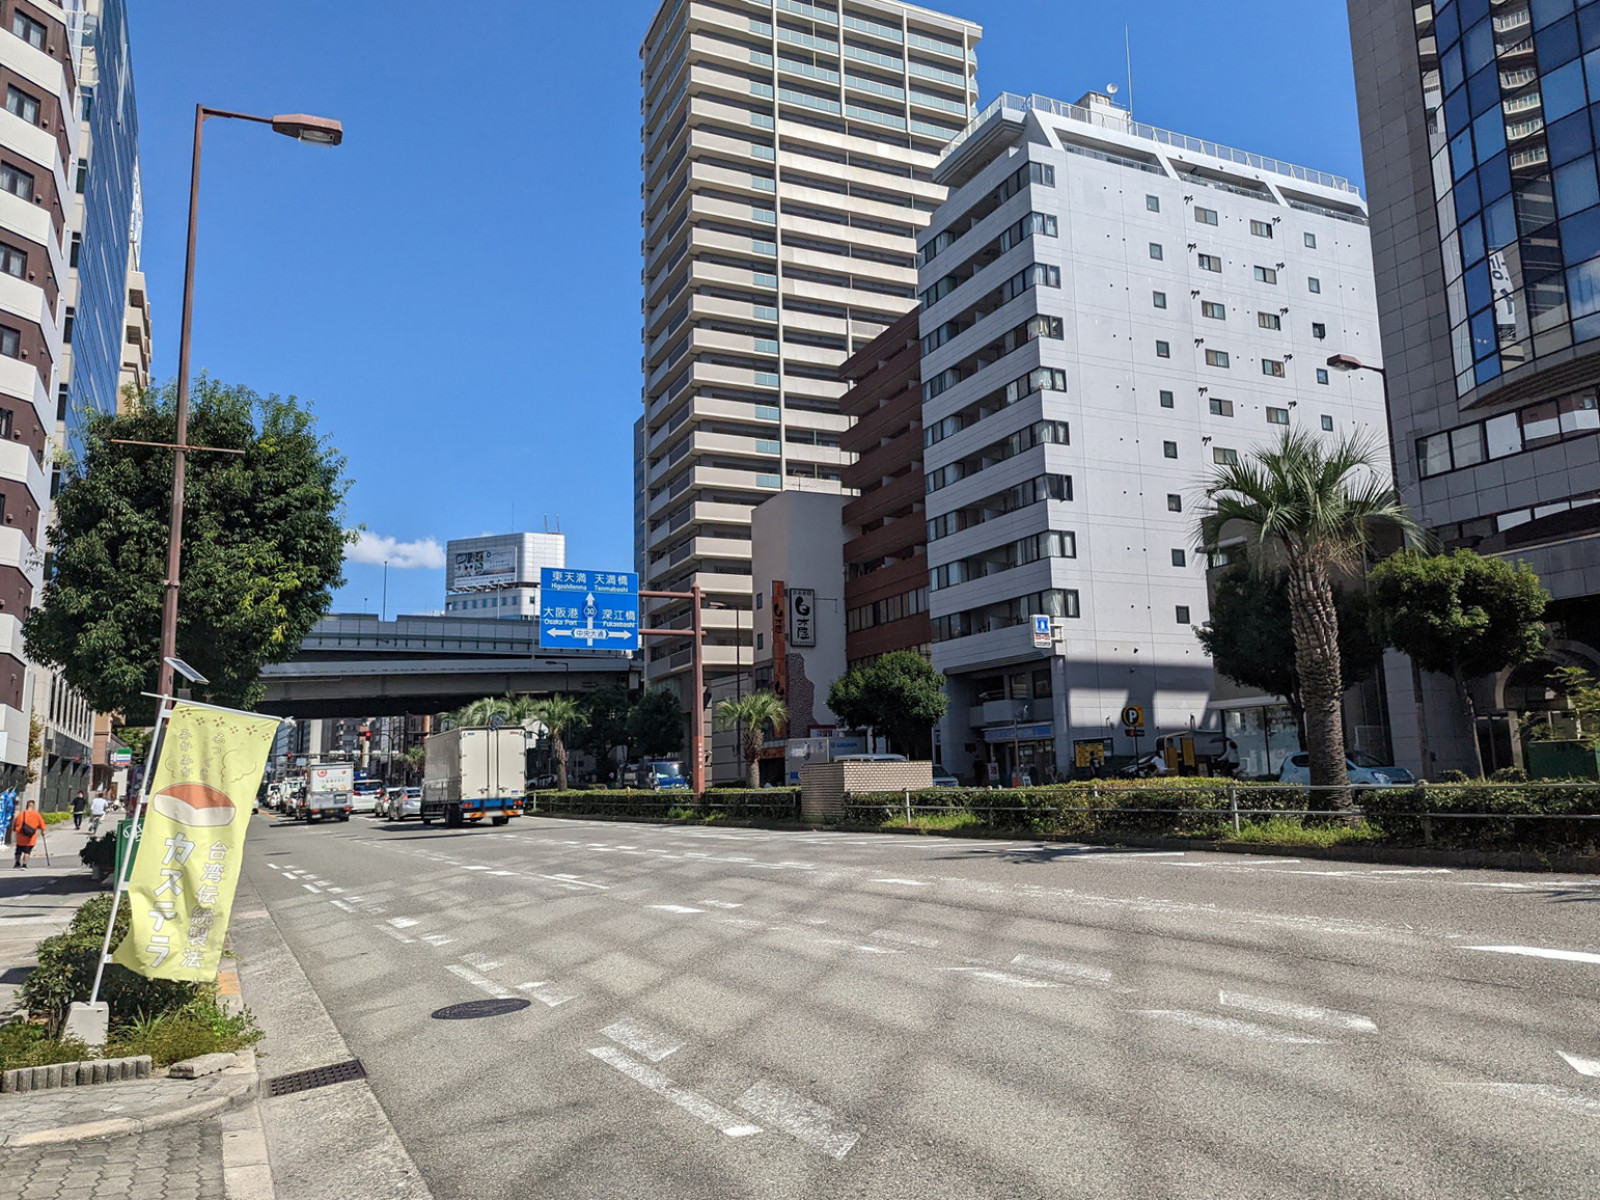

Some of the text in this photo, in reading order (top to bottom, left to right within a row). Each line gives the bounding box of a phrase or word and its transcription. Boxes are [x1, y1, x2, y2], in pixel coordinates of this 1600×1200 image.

[552, 571, 587, 583] 東天満
[594, 573, 628, 585] 天満橋
[543, 607, 579, 619] 大阪港
[586, 608, 595, 616] 30
[602, 609, 636, 621] 深江橋
[576, 630, 604, 638] 中央大通
[1129, 709, 1137, 723] P
[146, 832, 195, 968] カステラ
[181, 841, 228, 968] 台湾伝統製法
